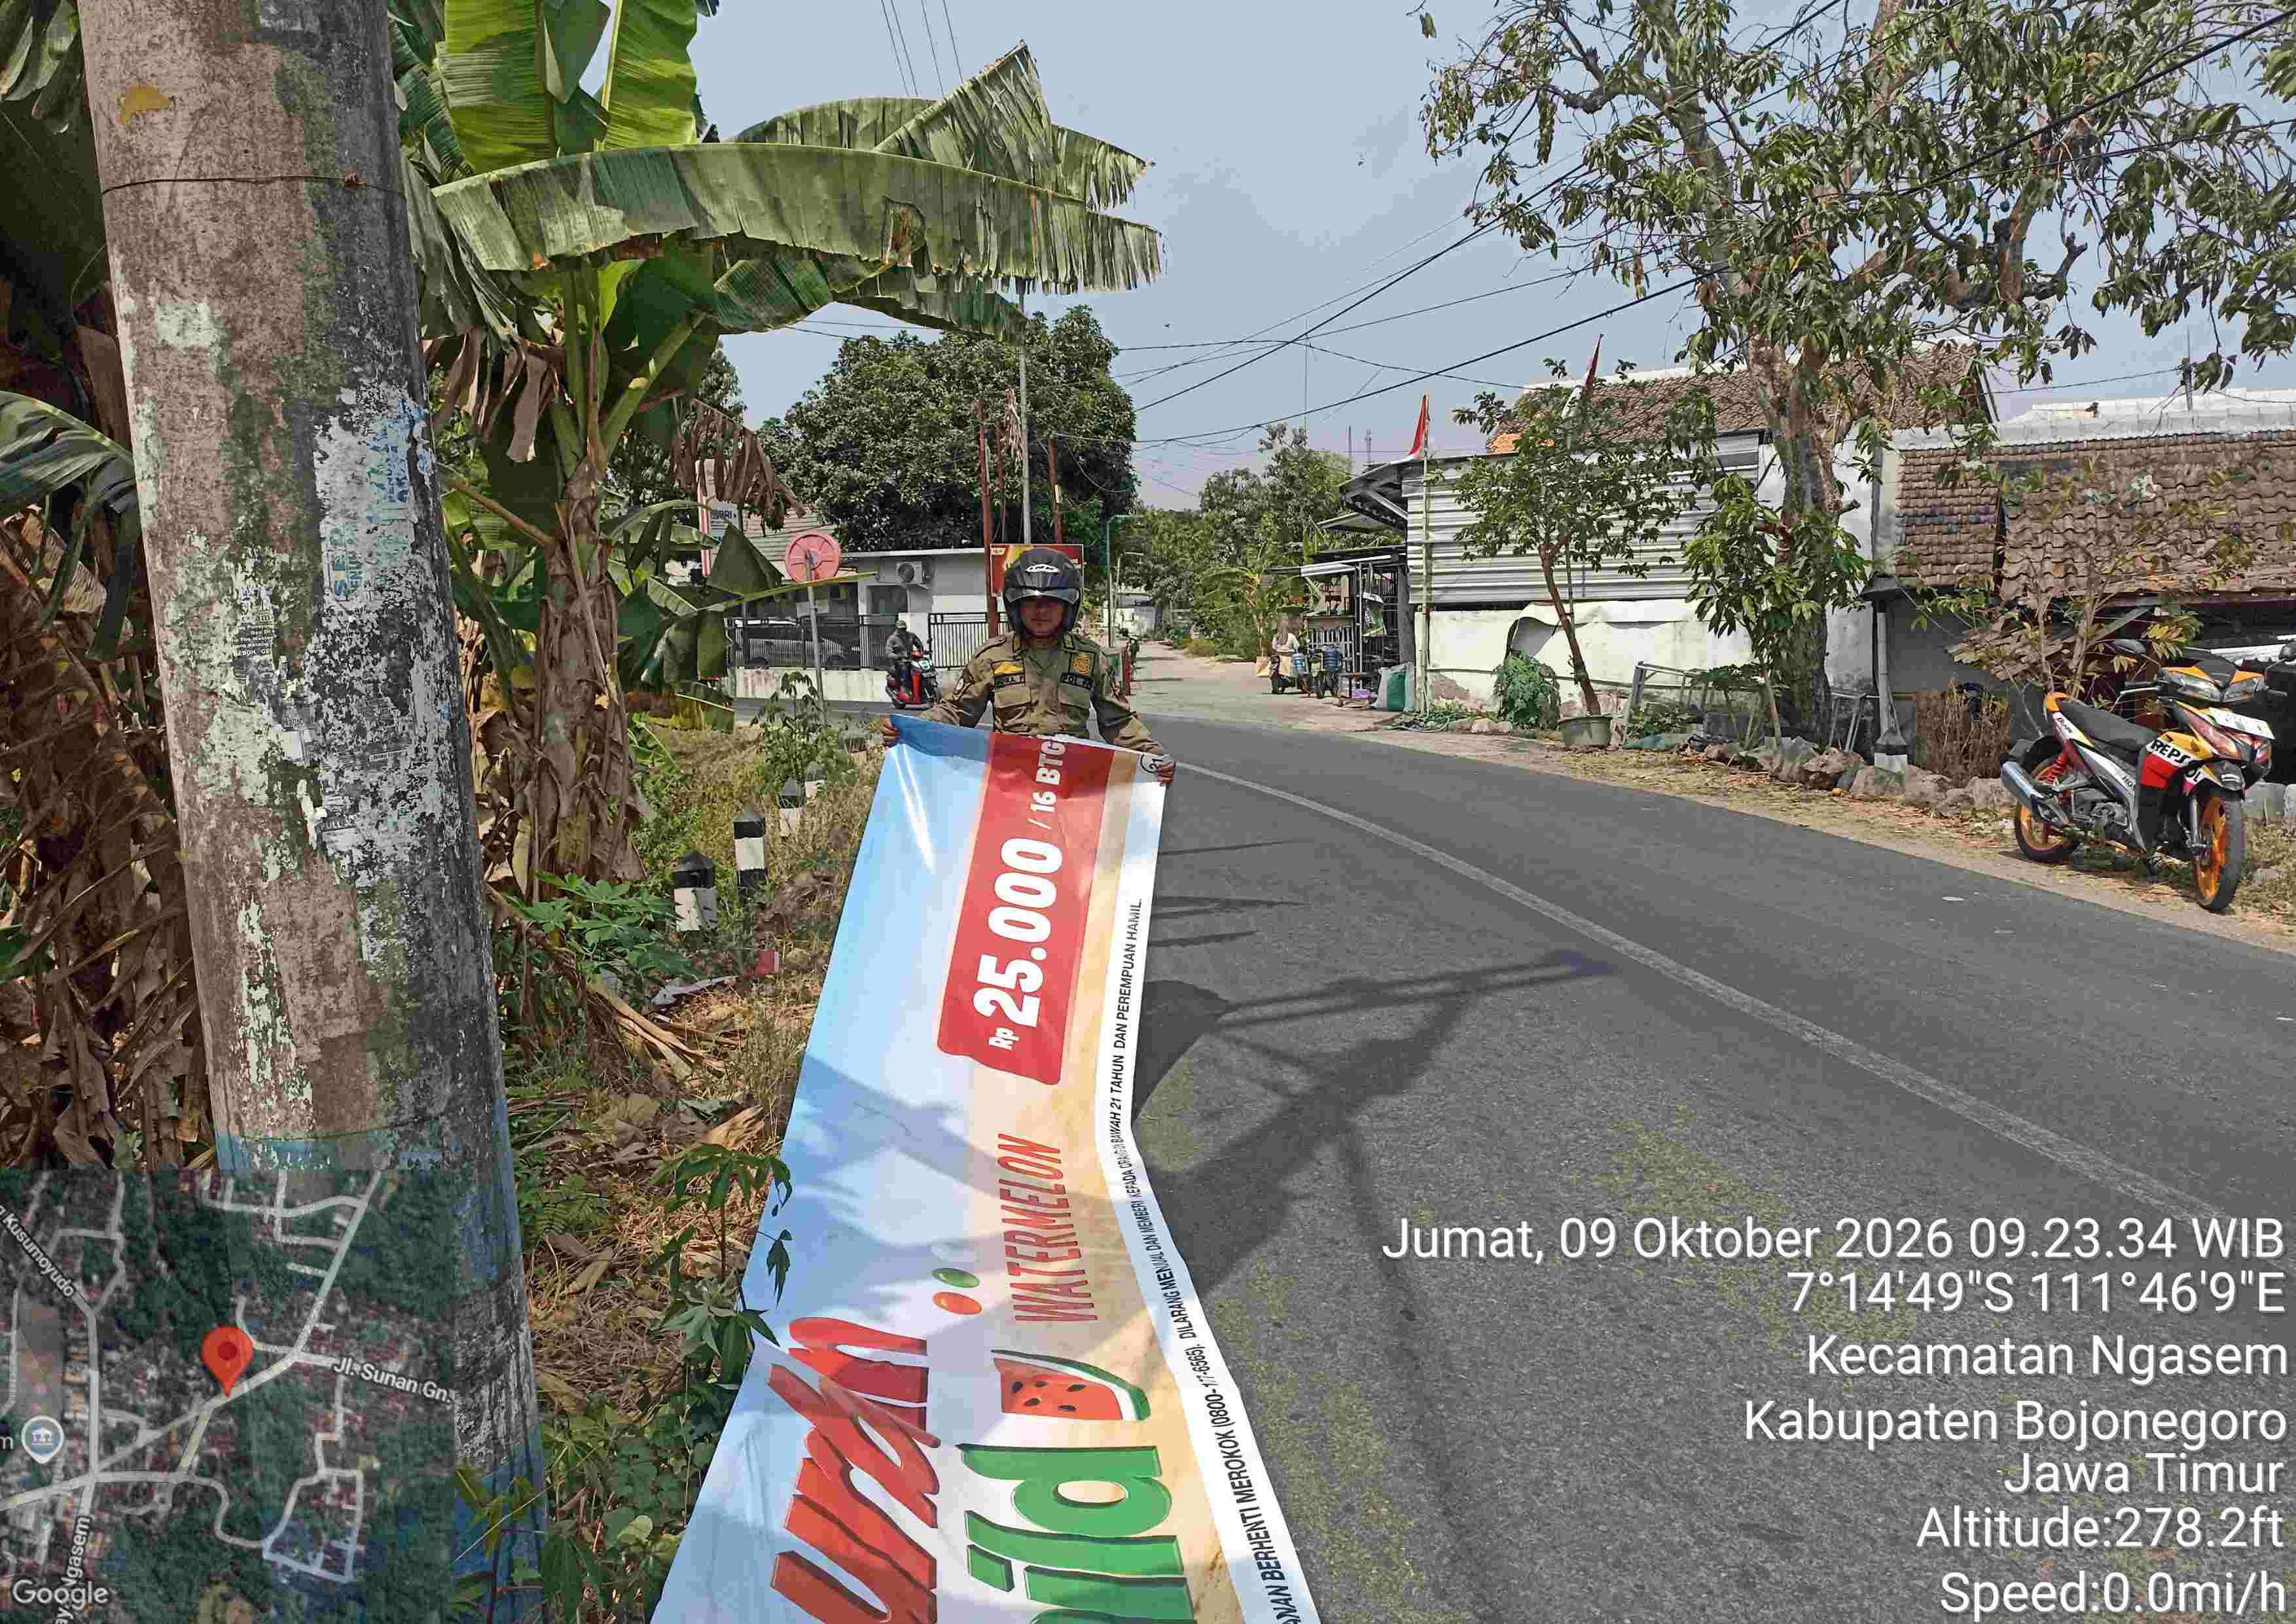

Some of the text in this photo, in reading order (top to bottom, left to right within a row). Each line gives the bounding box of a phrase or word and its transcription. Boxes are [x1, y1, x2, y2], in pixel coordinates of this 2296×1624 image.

[1030, 791, 1057, 812] 16
[974, 837, 1064, 1028] 25.000
[1126, 898, 1142, 941] HAMIL.
[1115, 943, 1136, 1020] PEREMPUAN
[988, 1028, 1020, 1051] Rp
[1113, 1023, 1128, 1049] DAN
[1109, 1055, 1124, 1093] TAHUN
[1110, 1097, 1122, 1111] 21
[1109, 1111, 1124, 1143] BAWAH
[1120, 1169, 1142, 1198] KEPADA
[997, 1132, 1099, 1322] WATERMELON
[1143, 1235, 1162, 1251] DAN
[1164, 1291, 1197, 1339] DILARANG
[1215, 1430, 1257, 1504] MEROKOK
[955, 1443, 1198, 1624] ild
[1239, 1506, 1285, 1581] BERHENTI
